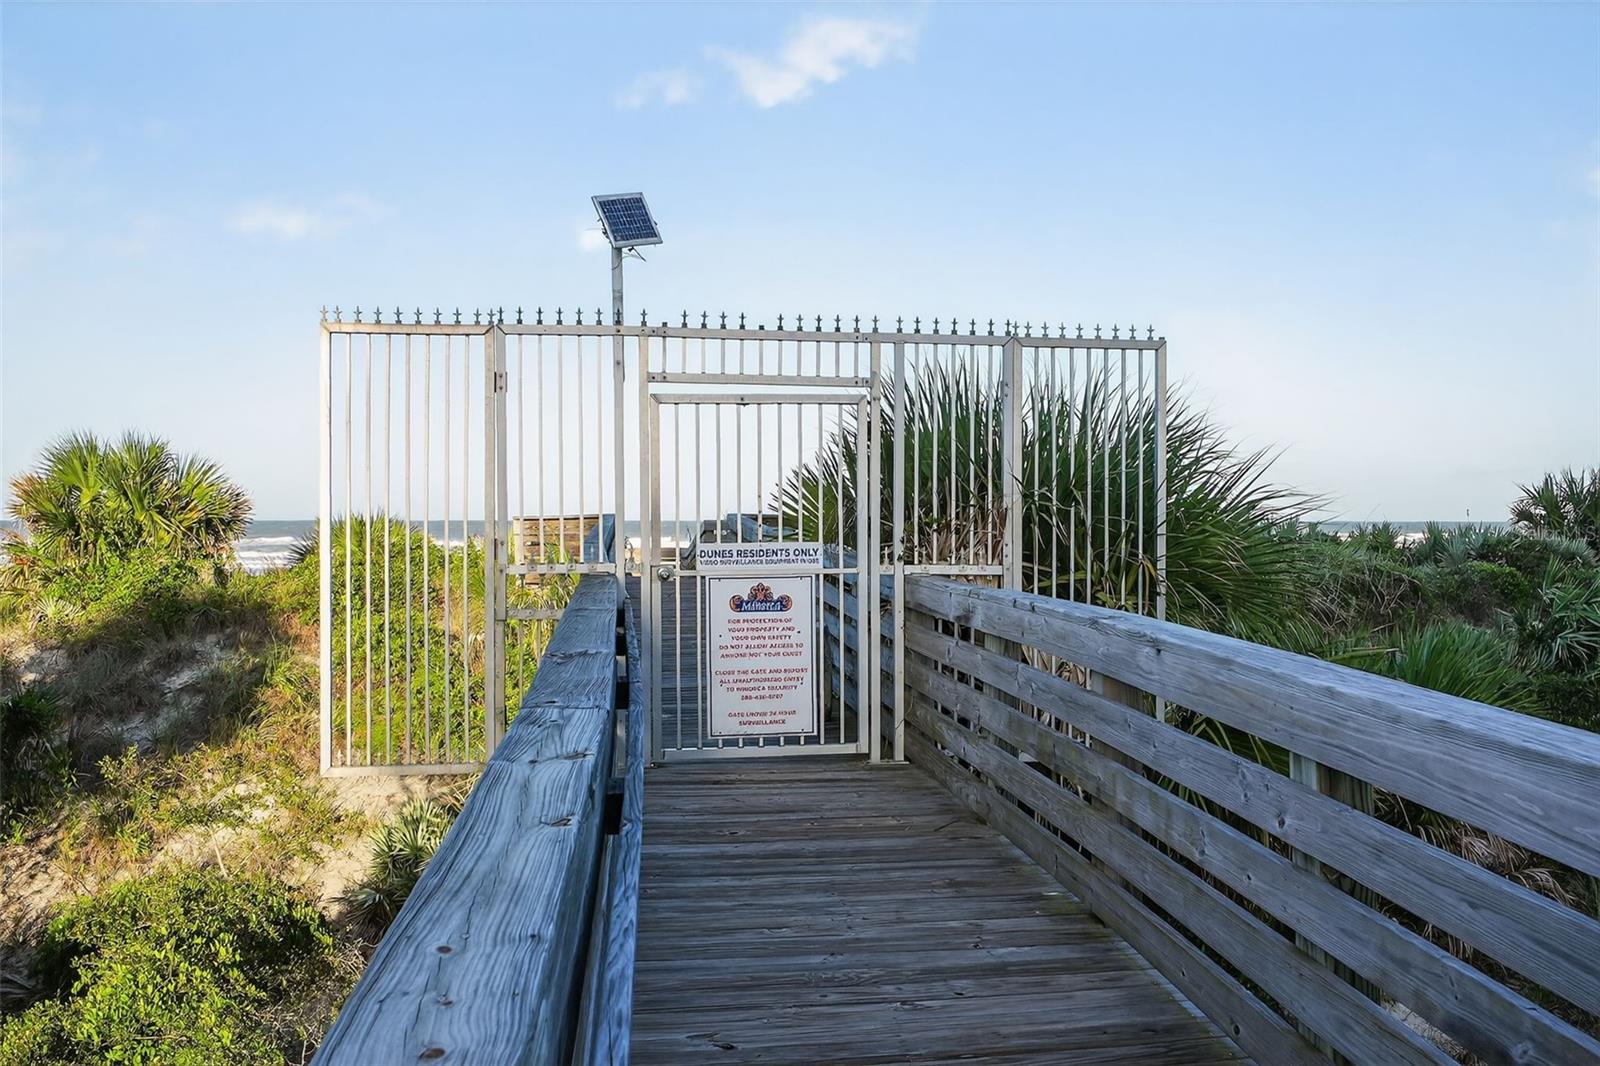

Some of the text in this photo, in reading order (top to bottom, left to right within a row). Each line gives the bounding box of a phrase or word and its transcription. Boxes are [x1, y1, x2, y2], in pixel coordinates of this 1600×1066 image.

[700, 547, 819, 559] DUNES RESIDENTS ONLY
